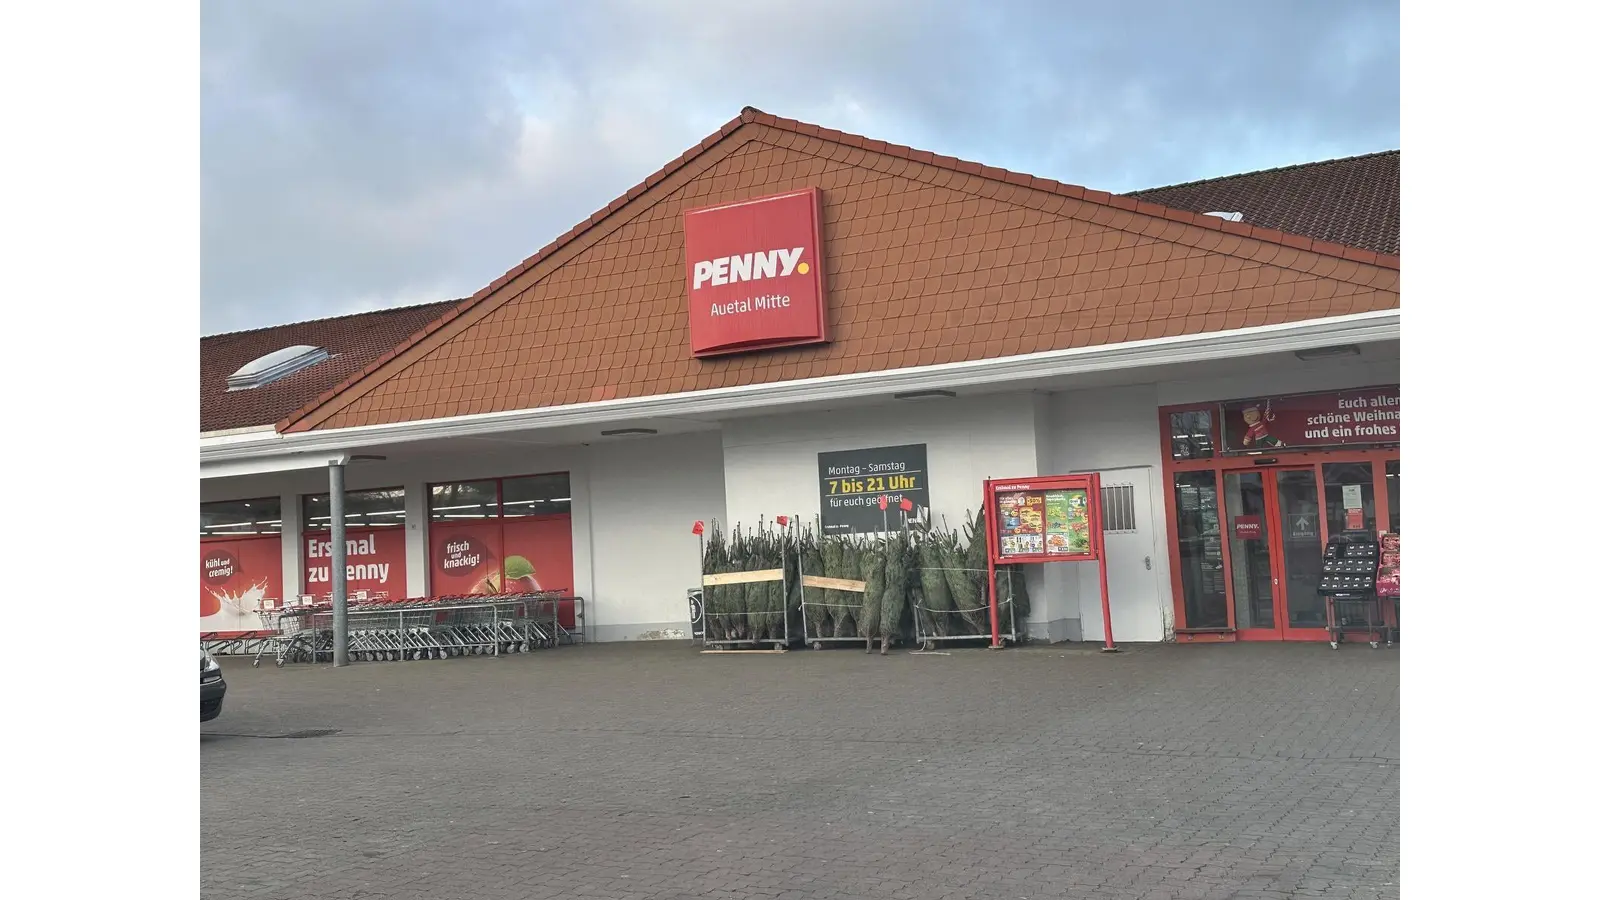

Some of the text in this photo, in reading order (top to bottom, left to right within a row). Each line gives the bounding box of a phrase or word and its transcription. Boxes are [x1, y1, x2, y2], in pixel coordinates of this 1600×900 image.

[711, 294, 791, 317] Auetal Mitte
[1338, 397, 1367, 409] Euch
[1307, 412, 1351, 425] schöne
[1304, 424, 1397, 438] und ein frohes
[828, 464, 860, 476] Montag
[868, 461, 906, 473] Samstag
[829, 474, 916, 494] 7 bis 21 Uhr
[830, 498, 843, 508] für
[844, 496, 864, 507] euch
[308, 534, 376, 558] Ersmal
[446, 540, 470, 554] frisch
[443, 553, 480, 570] knackig!
[450, 551, 462, 559] und
[205, 558, 220, 568] kühl
[208, 565, 233, 577] cremig!
[308, 563, 390, 584] zu enny
